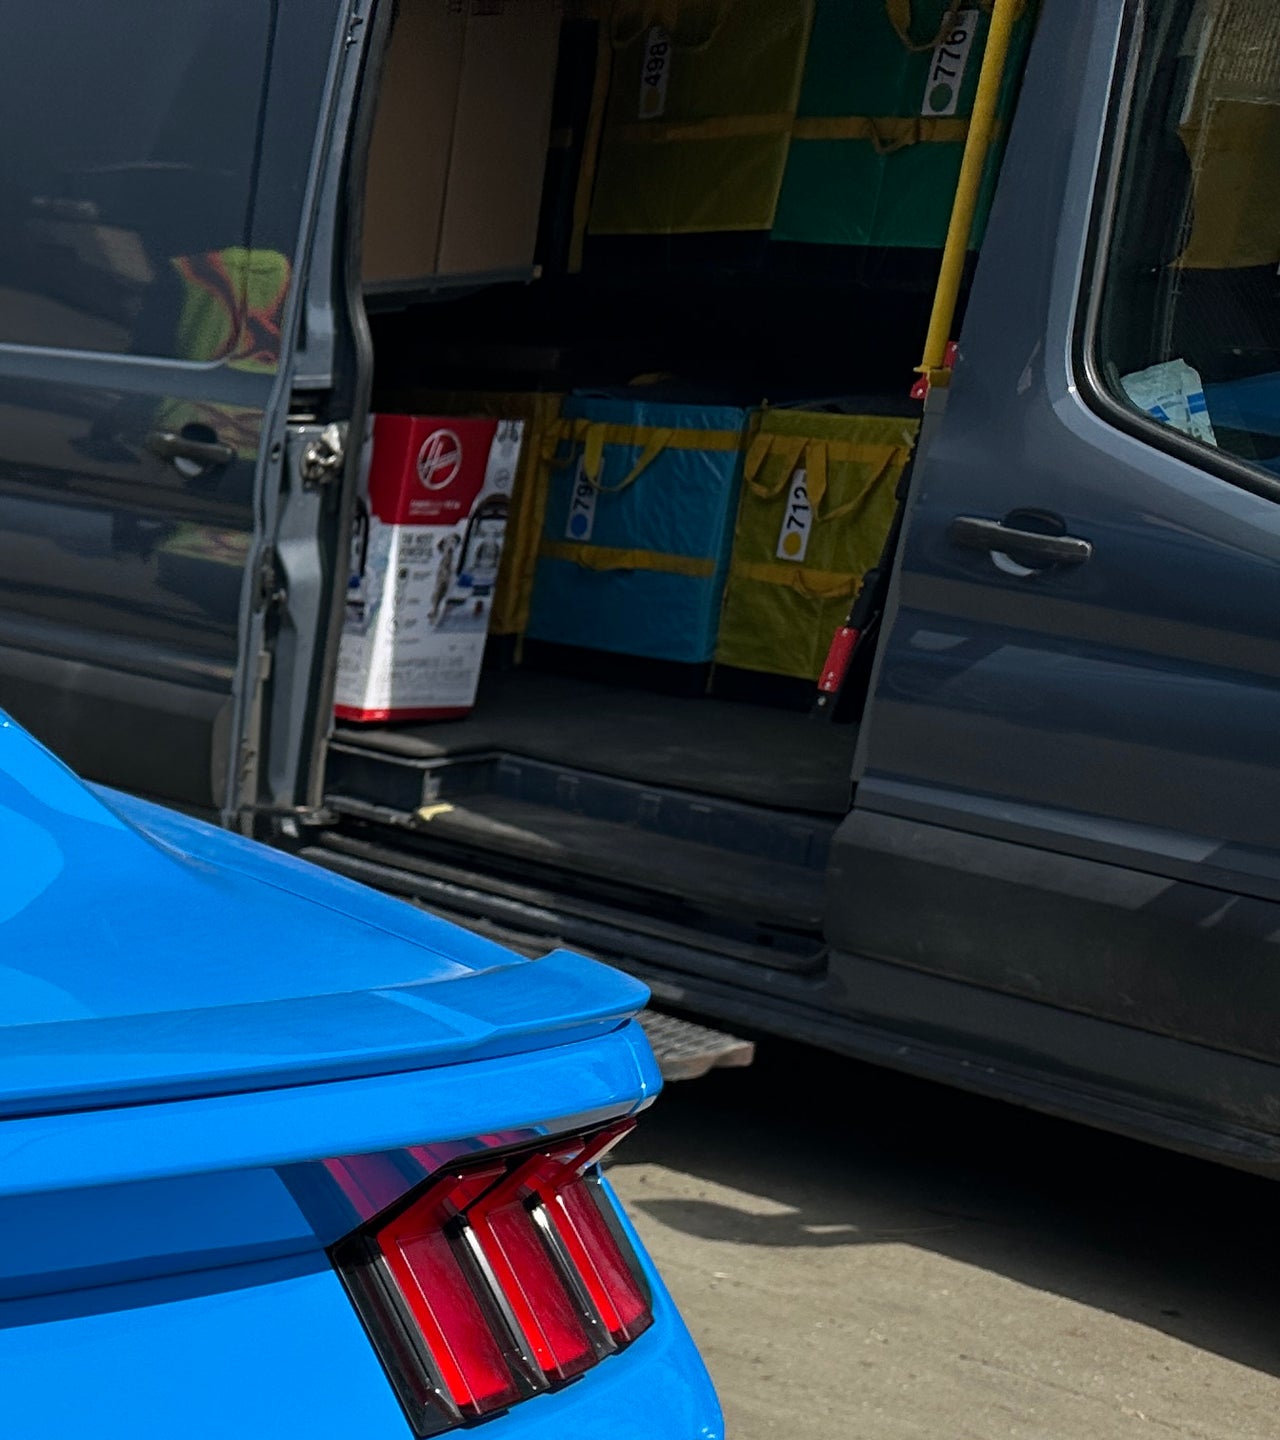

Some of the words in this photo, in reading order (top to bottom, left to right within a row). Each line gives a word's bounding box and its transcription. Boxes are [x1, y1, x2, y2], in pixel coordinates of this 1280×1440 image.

[644, 41, 668, 87] 498
[933, 29, 967, 81] 776
[786, 485, 810, 530] 712
